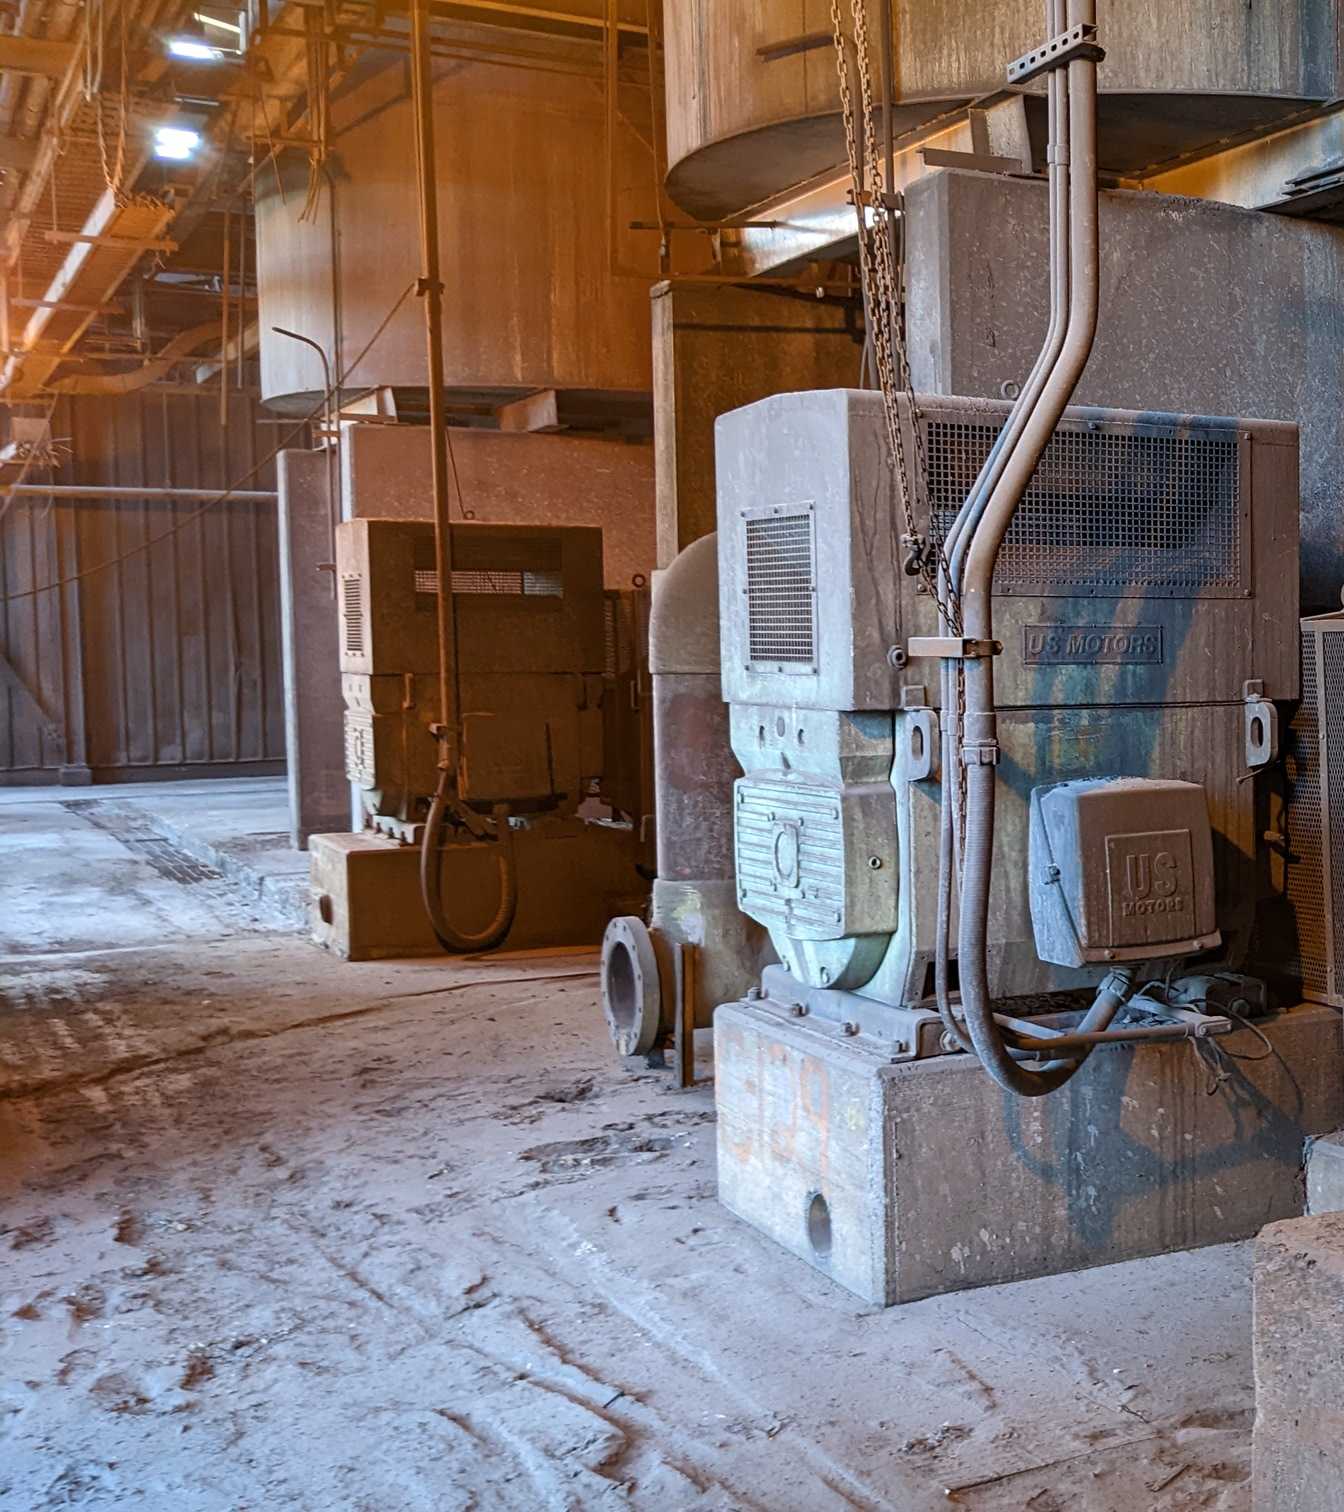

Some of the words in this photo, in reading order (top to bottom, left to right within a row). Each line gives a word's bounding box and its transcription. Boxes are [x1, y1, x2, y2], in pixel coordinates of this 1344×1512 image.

[1029, 634, 1058, 655] US
[1066, 634, 1155, 655] MOTORS
[1126, 851, 1177, 899] US
[1121, 897, 1184, 917] MOTORS
